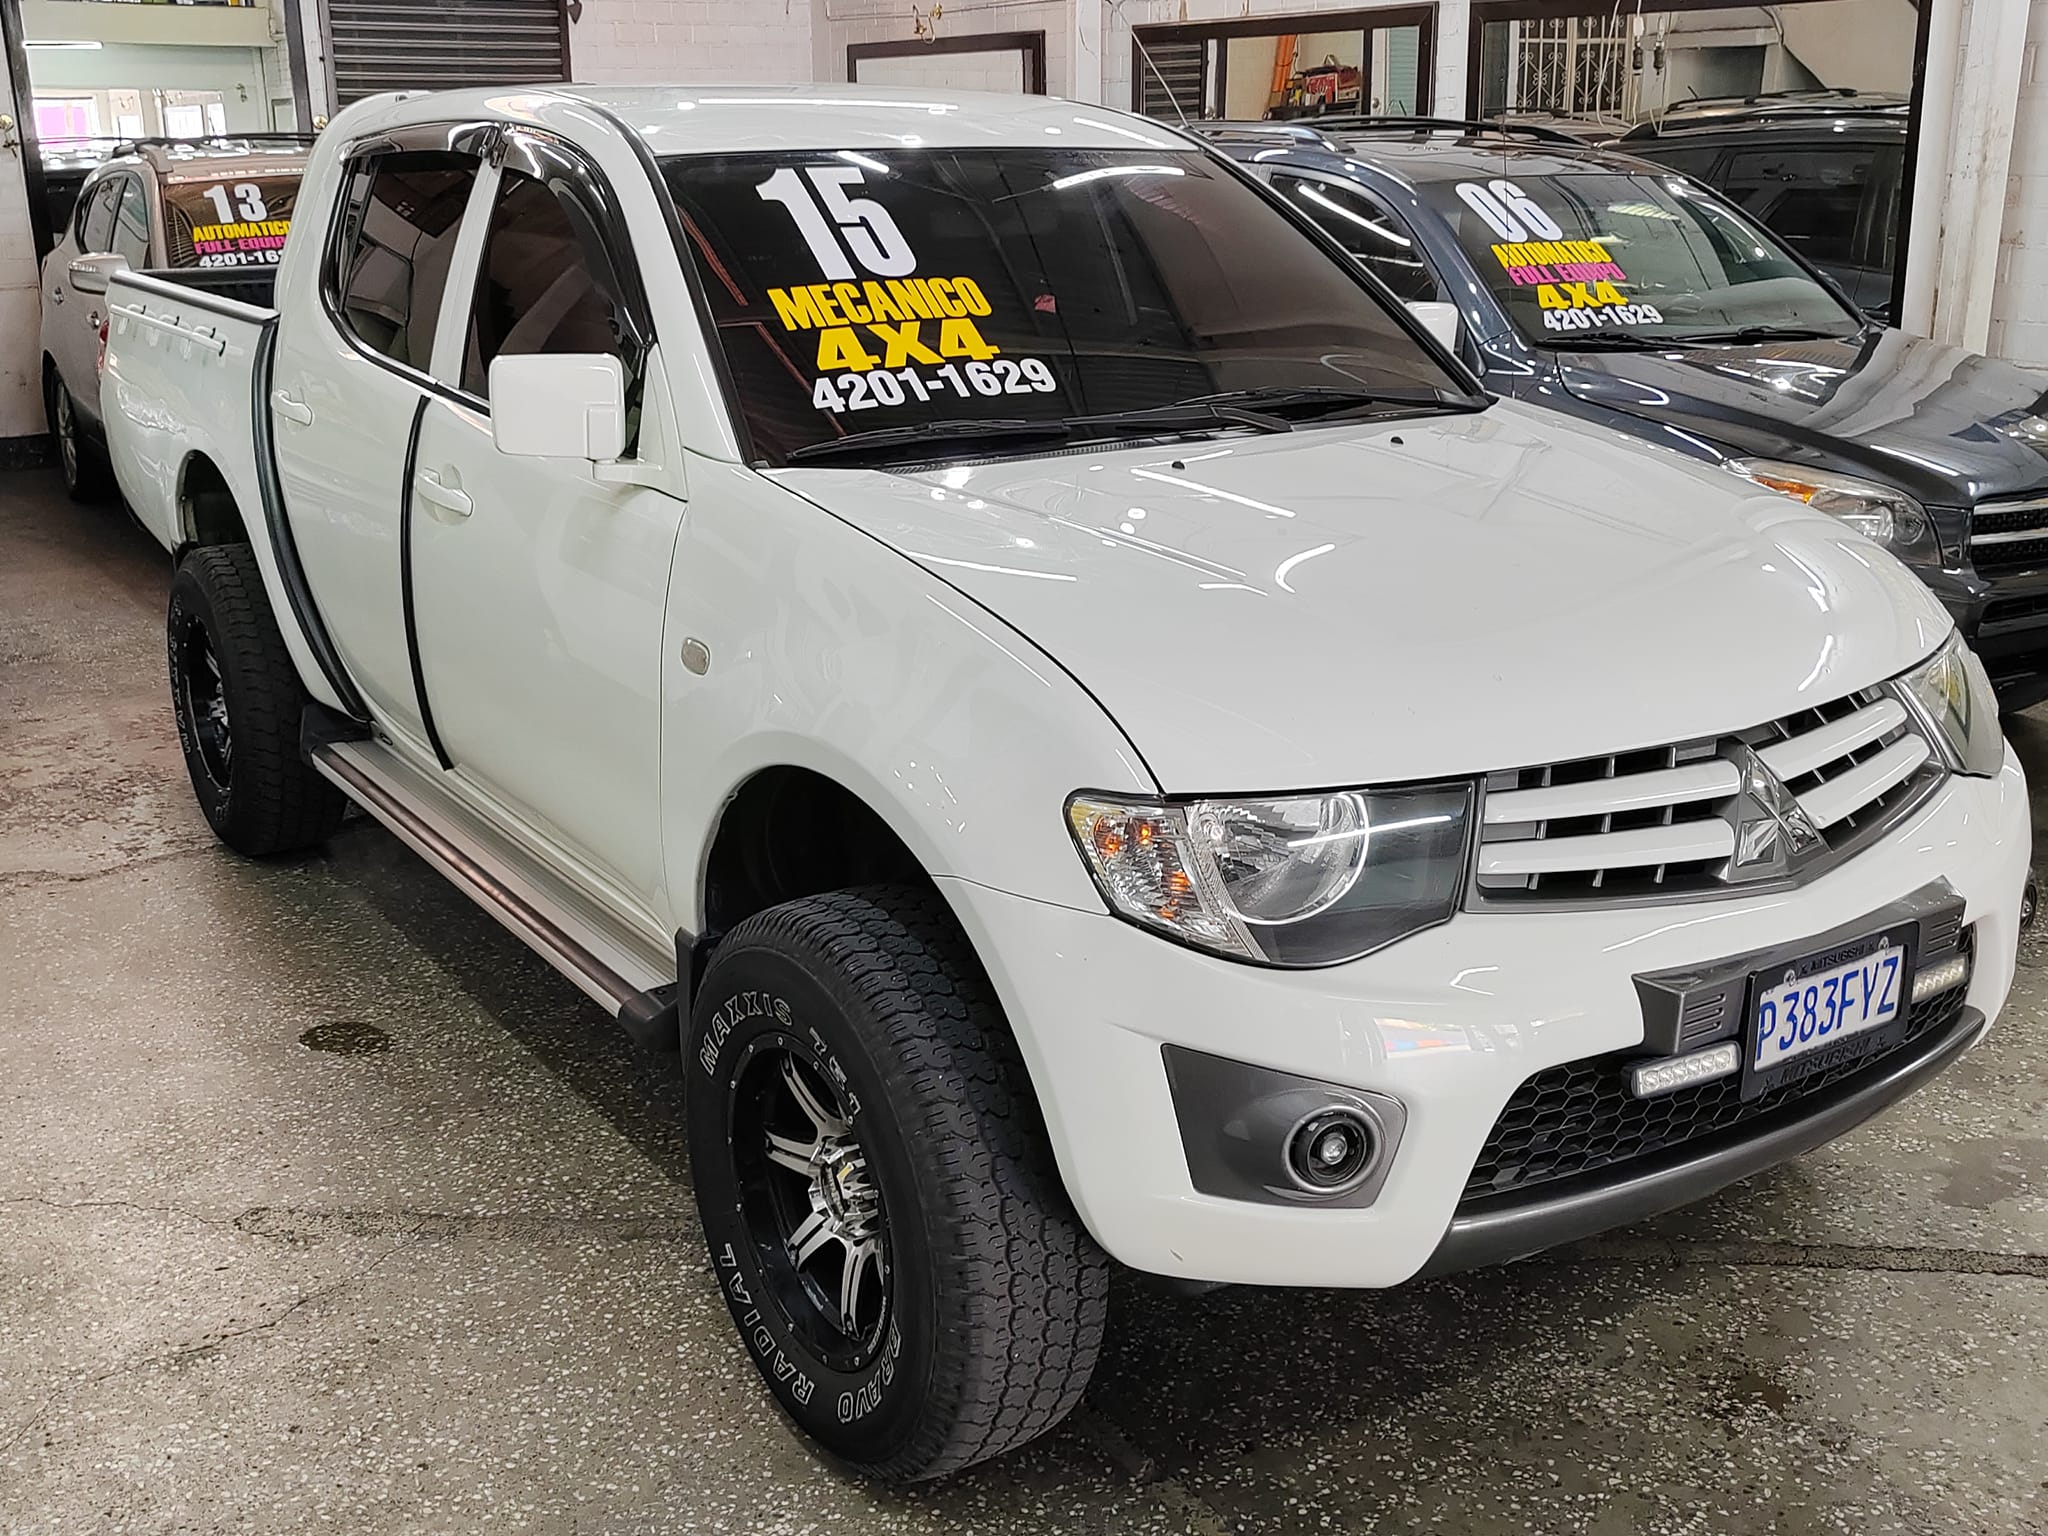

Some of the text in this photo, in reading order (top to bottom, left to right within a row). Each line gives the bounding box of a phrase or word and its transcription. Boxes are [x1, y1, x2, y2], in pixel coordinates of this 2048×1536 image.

[203, 183, 267, 224] 13
[755, 167, 917, 280] 15
[1455, 180, 1563, 242] 06
[194, 239, 236, 254] FULL
[199, 250, 283, 268] 4201-16
[1490, 241, 1613, 269] AUTOMATICO
[1508, 262, 1627, 286] FULL EQUIPO
[1537, 280, 1629, 310] 4X4
[767, 276, 993, 332] MECANICO
[1543, 303, 1664, 331] 4201-1629
[816, 318, 1001, 372] 4X4
[812, 358, 1057, 413] 4201-1629
[699, 991, 793, 1077] MAXXIS
[1756, 956, 1899, 1061] P383FYZ
[719, 1242, 815, 1405] RADIAL
[837, 1313, 901, 1423] BRAVO
